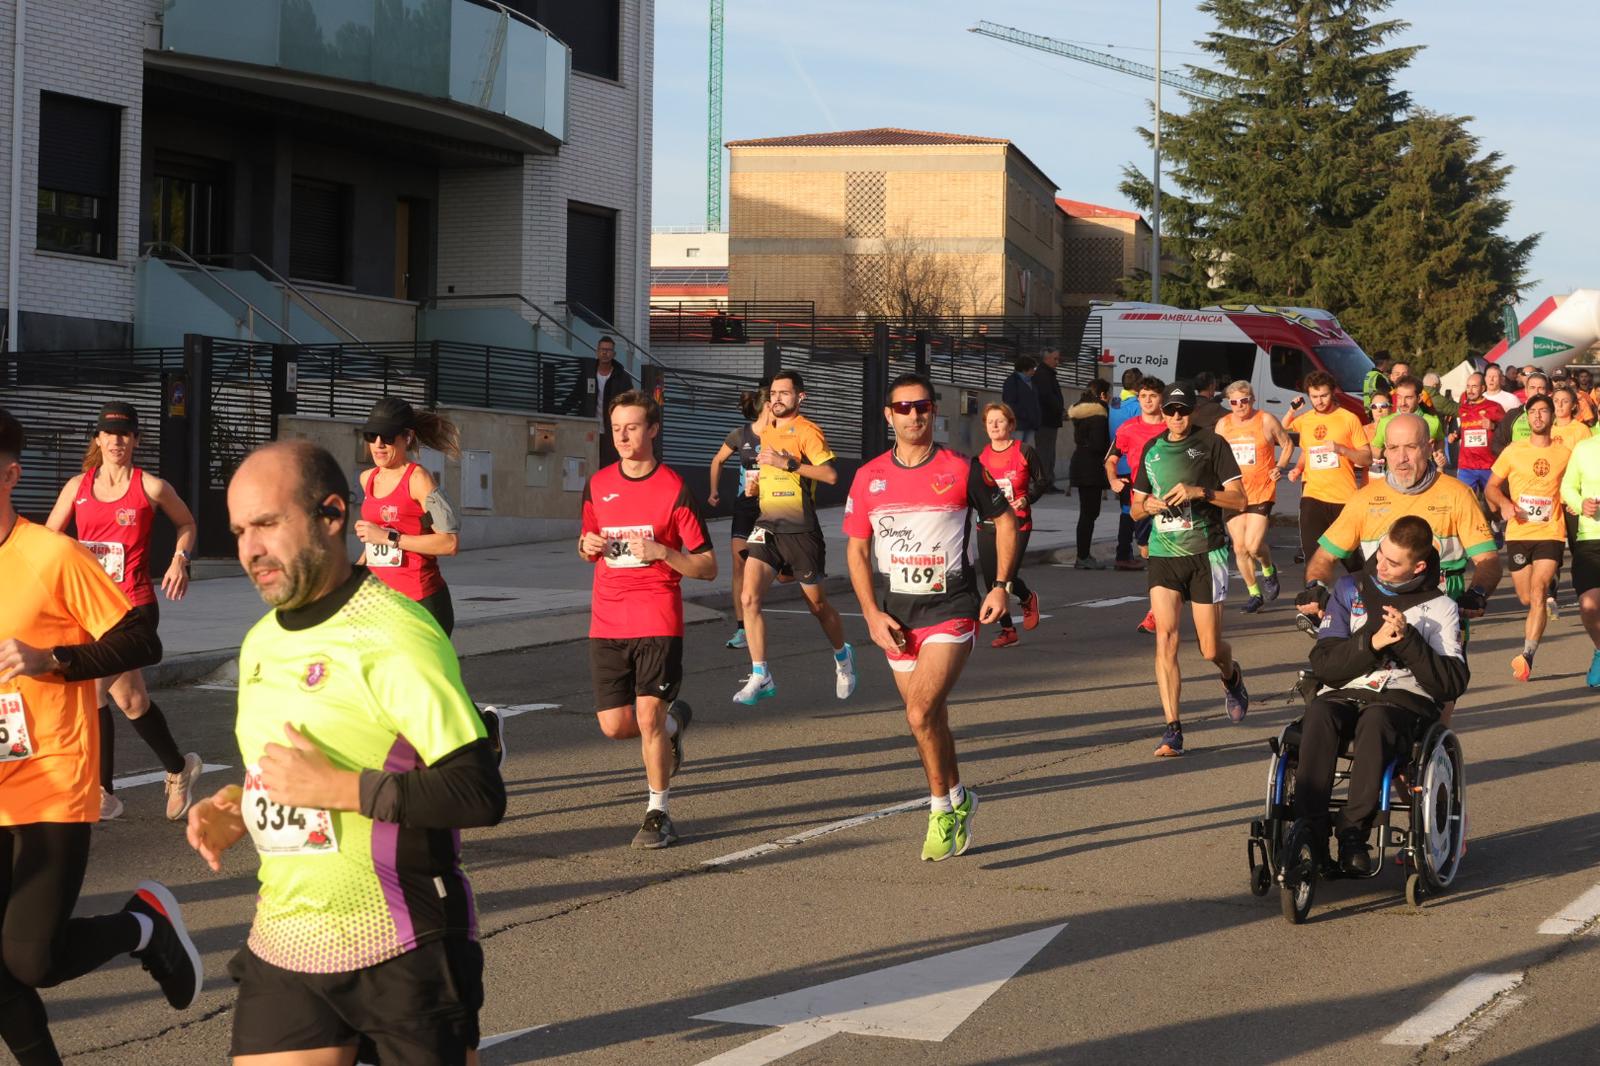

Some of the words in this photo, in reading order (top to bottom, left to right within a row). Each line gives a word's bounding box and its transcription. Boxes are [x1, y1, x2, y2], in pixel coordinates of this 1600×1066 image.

[1160, 313, 1223, 323] AMBULANCIA
[1118, 354, 1142, 365] Cruz
[1145, 354, 1169, 367] Roja
[1316, 453, 1328, 463] 35
[1529, 505, 1542, 516] 36
[879, 515, 915, 540] Simón
[373, 543, 388, 557] 30
[891, 554, 945, 566] bedunia
[901, 567, 934, 584] 169
[256, 797, 306, 831] 334
